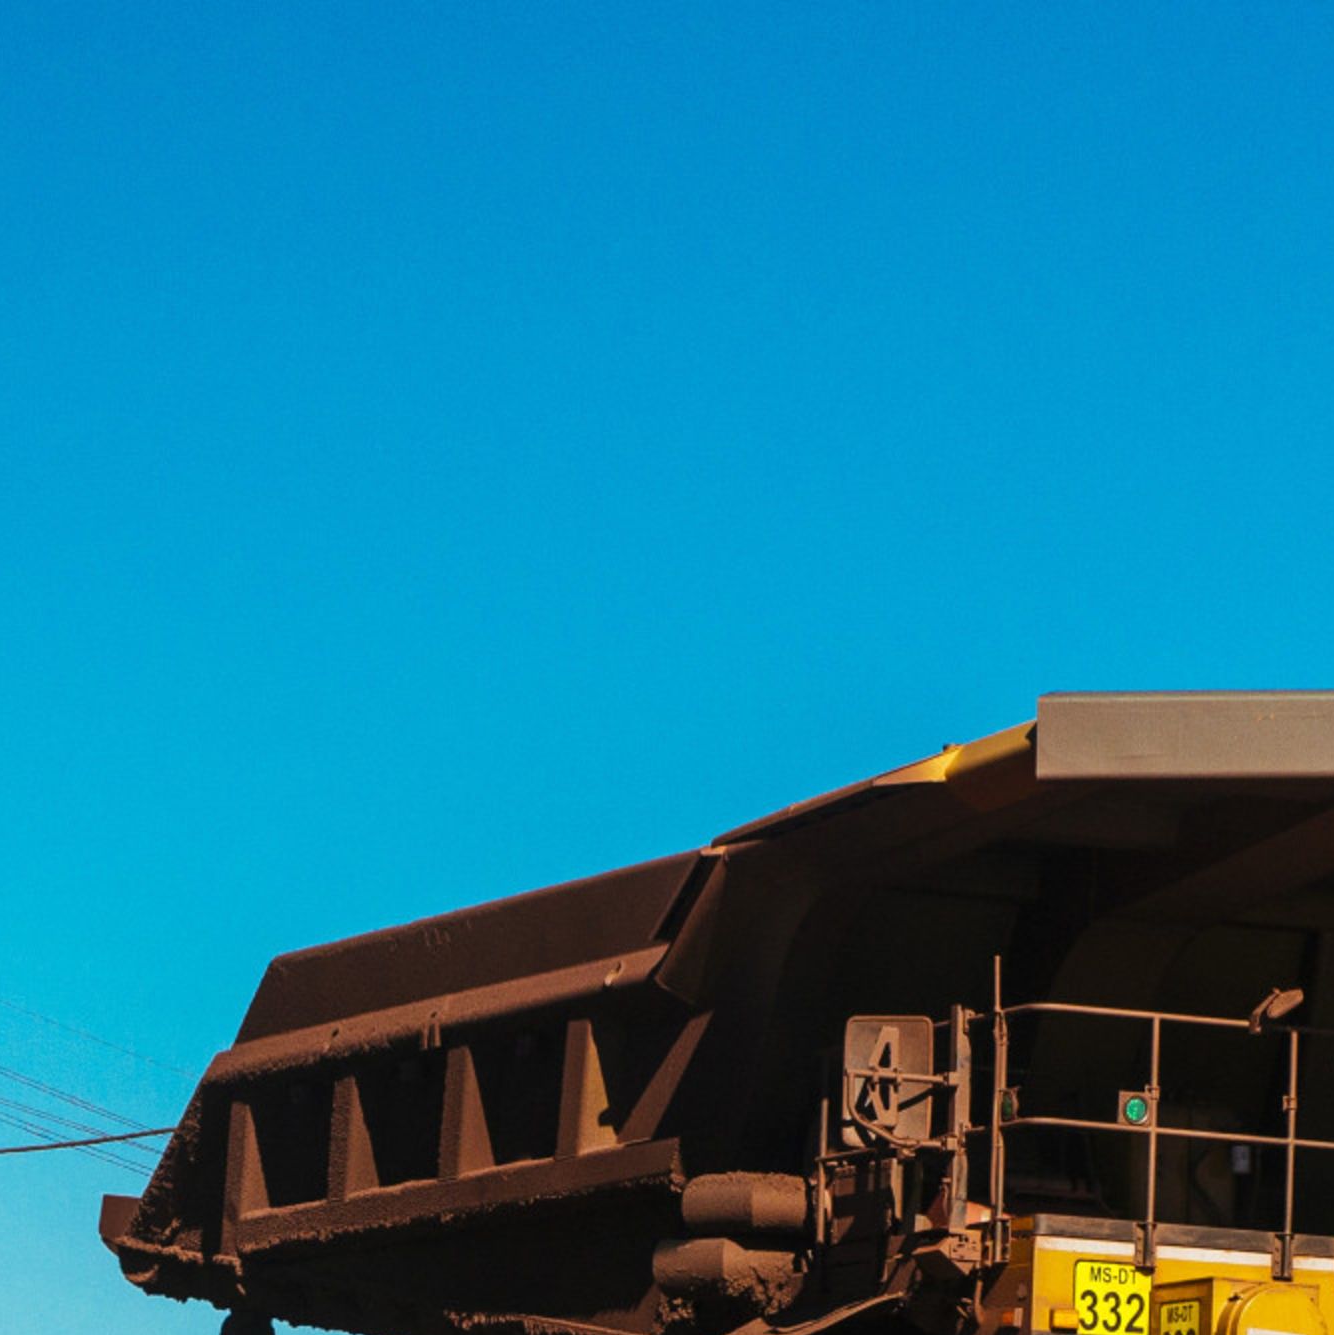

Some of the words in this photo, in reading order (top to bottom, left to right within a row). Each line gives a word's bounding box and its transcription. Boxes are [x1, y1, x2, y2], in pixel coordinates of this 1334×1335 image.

[1090, 1266, 1137, 1285] MS-DT
[1080, 1290, 1145, 1333] 332
[1167, 1305, 1194, 1324] MS-DT
